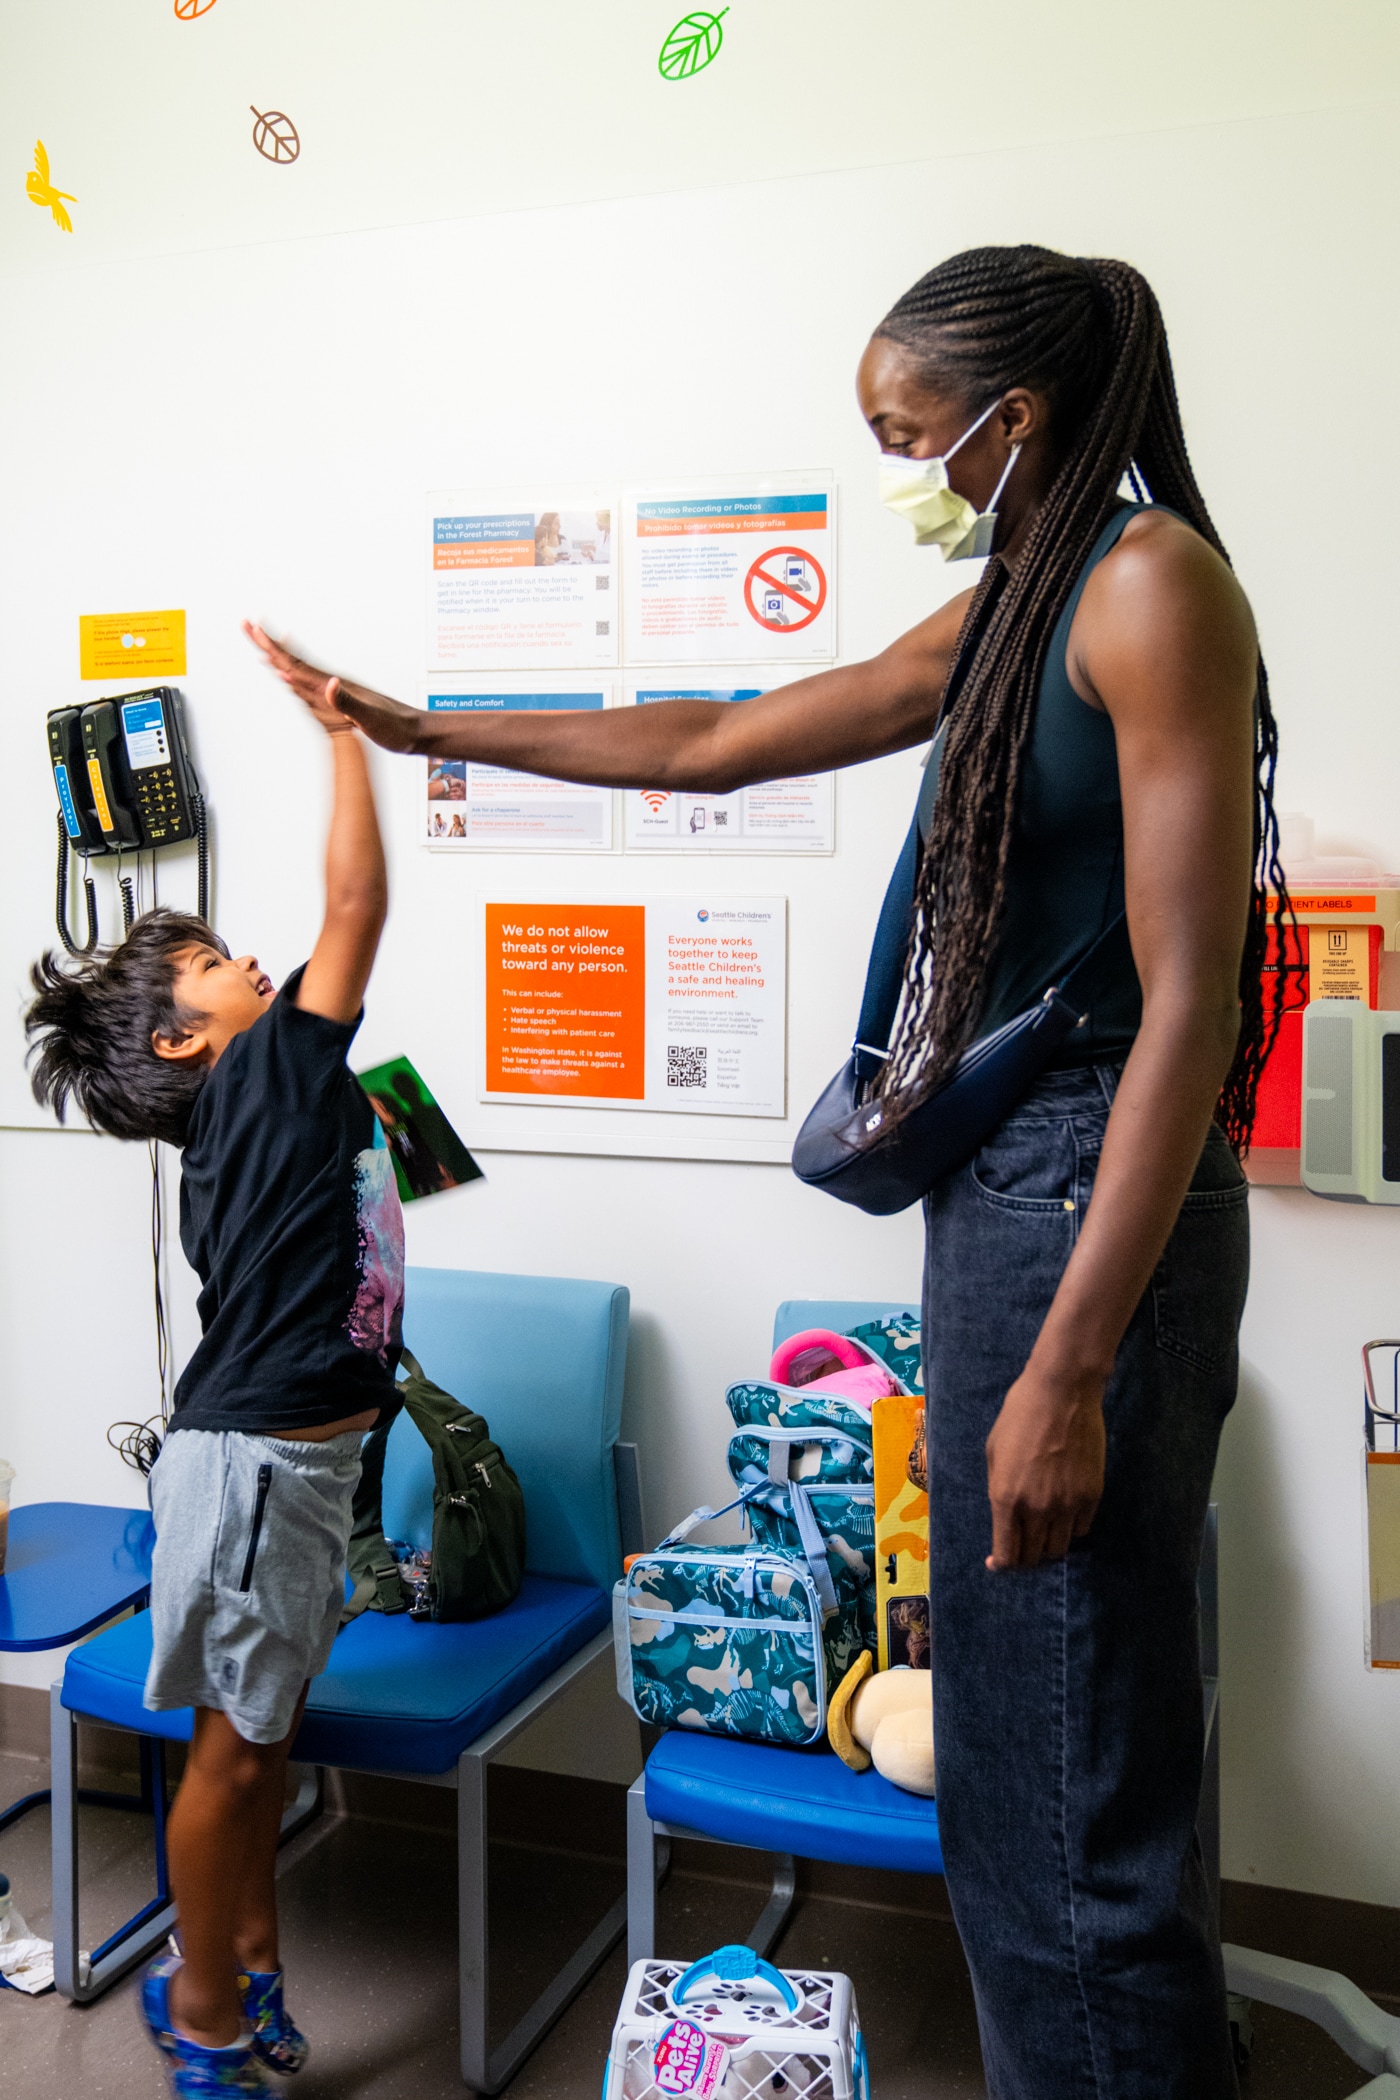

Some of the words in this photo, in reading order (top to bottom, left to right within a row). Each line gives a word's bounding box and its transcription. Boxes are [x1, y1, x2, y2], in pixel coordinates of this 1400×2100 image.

[682, 504, 721, 513] Recording
[483, 520, 530, 528] prescriptions
[743, 519, 786, 528] fotografías
[435, 700, 457, 708] Safety
[1317, 900, 1352, 908] LABELS
[502, 924, 523, 936] We
[527, 924, 544, 936] do
[548, 926, 570, 937] not
[574, 926, 609, 938] allow
[668, 935, 717, 946] Everyone
[721, 936, 752, 946] works
[502, 941, 547, 953] threats
[551, 945, 565, 954] or
[569, 943, 625, 956] violence
[668, 949, 714, 959] together
[717, 950, 728, 959] to
[732, 950, 758, 960] keep
[502, 958, 547, 970] toward
[552, 961, 574, 973] any
[579, 962, 628, 974] person.
[668, 961, 705, 971] Seattle
[709, 962, 762, 973] Children's
[678, 975, 699, 984] safe
[702, 976, 722, 984] and
[725, 976, 764, 988] healing
[668, 988, 738, 998] environment.
[511, 1027, 550, 1036] Interfering
[511, 1046, 555, 1055] Washington
[590, 1060, 618, 1068] against
[543, 1069, 581, 1077] employee.
[658, 2022, 690, 2091] Pets
[677, 2033, 703, 2088] Alive
